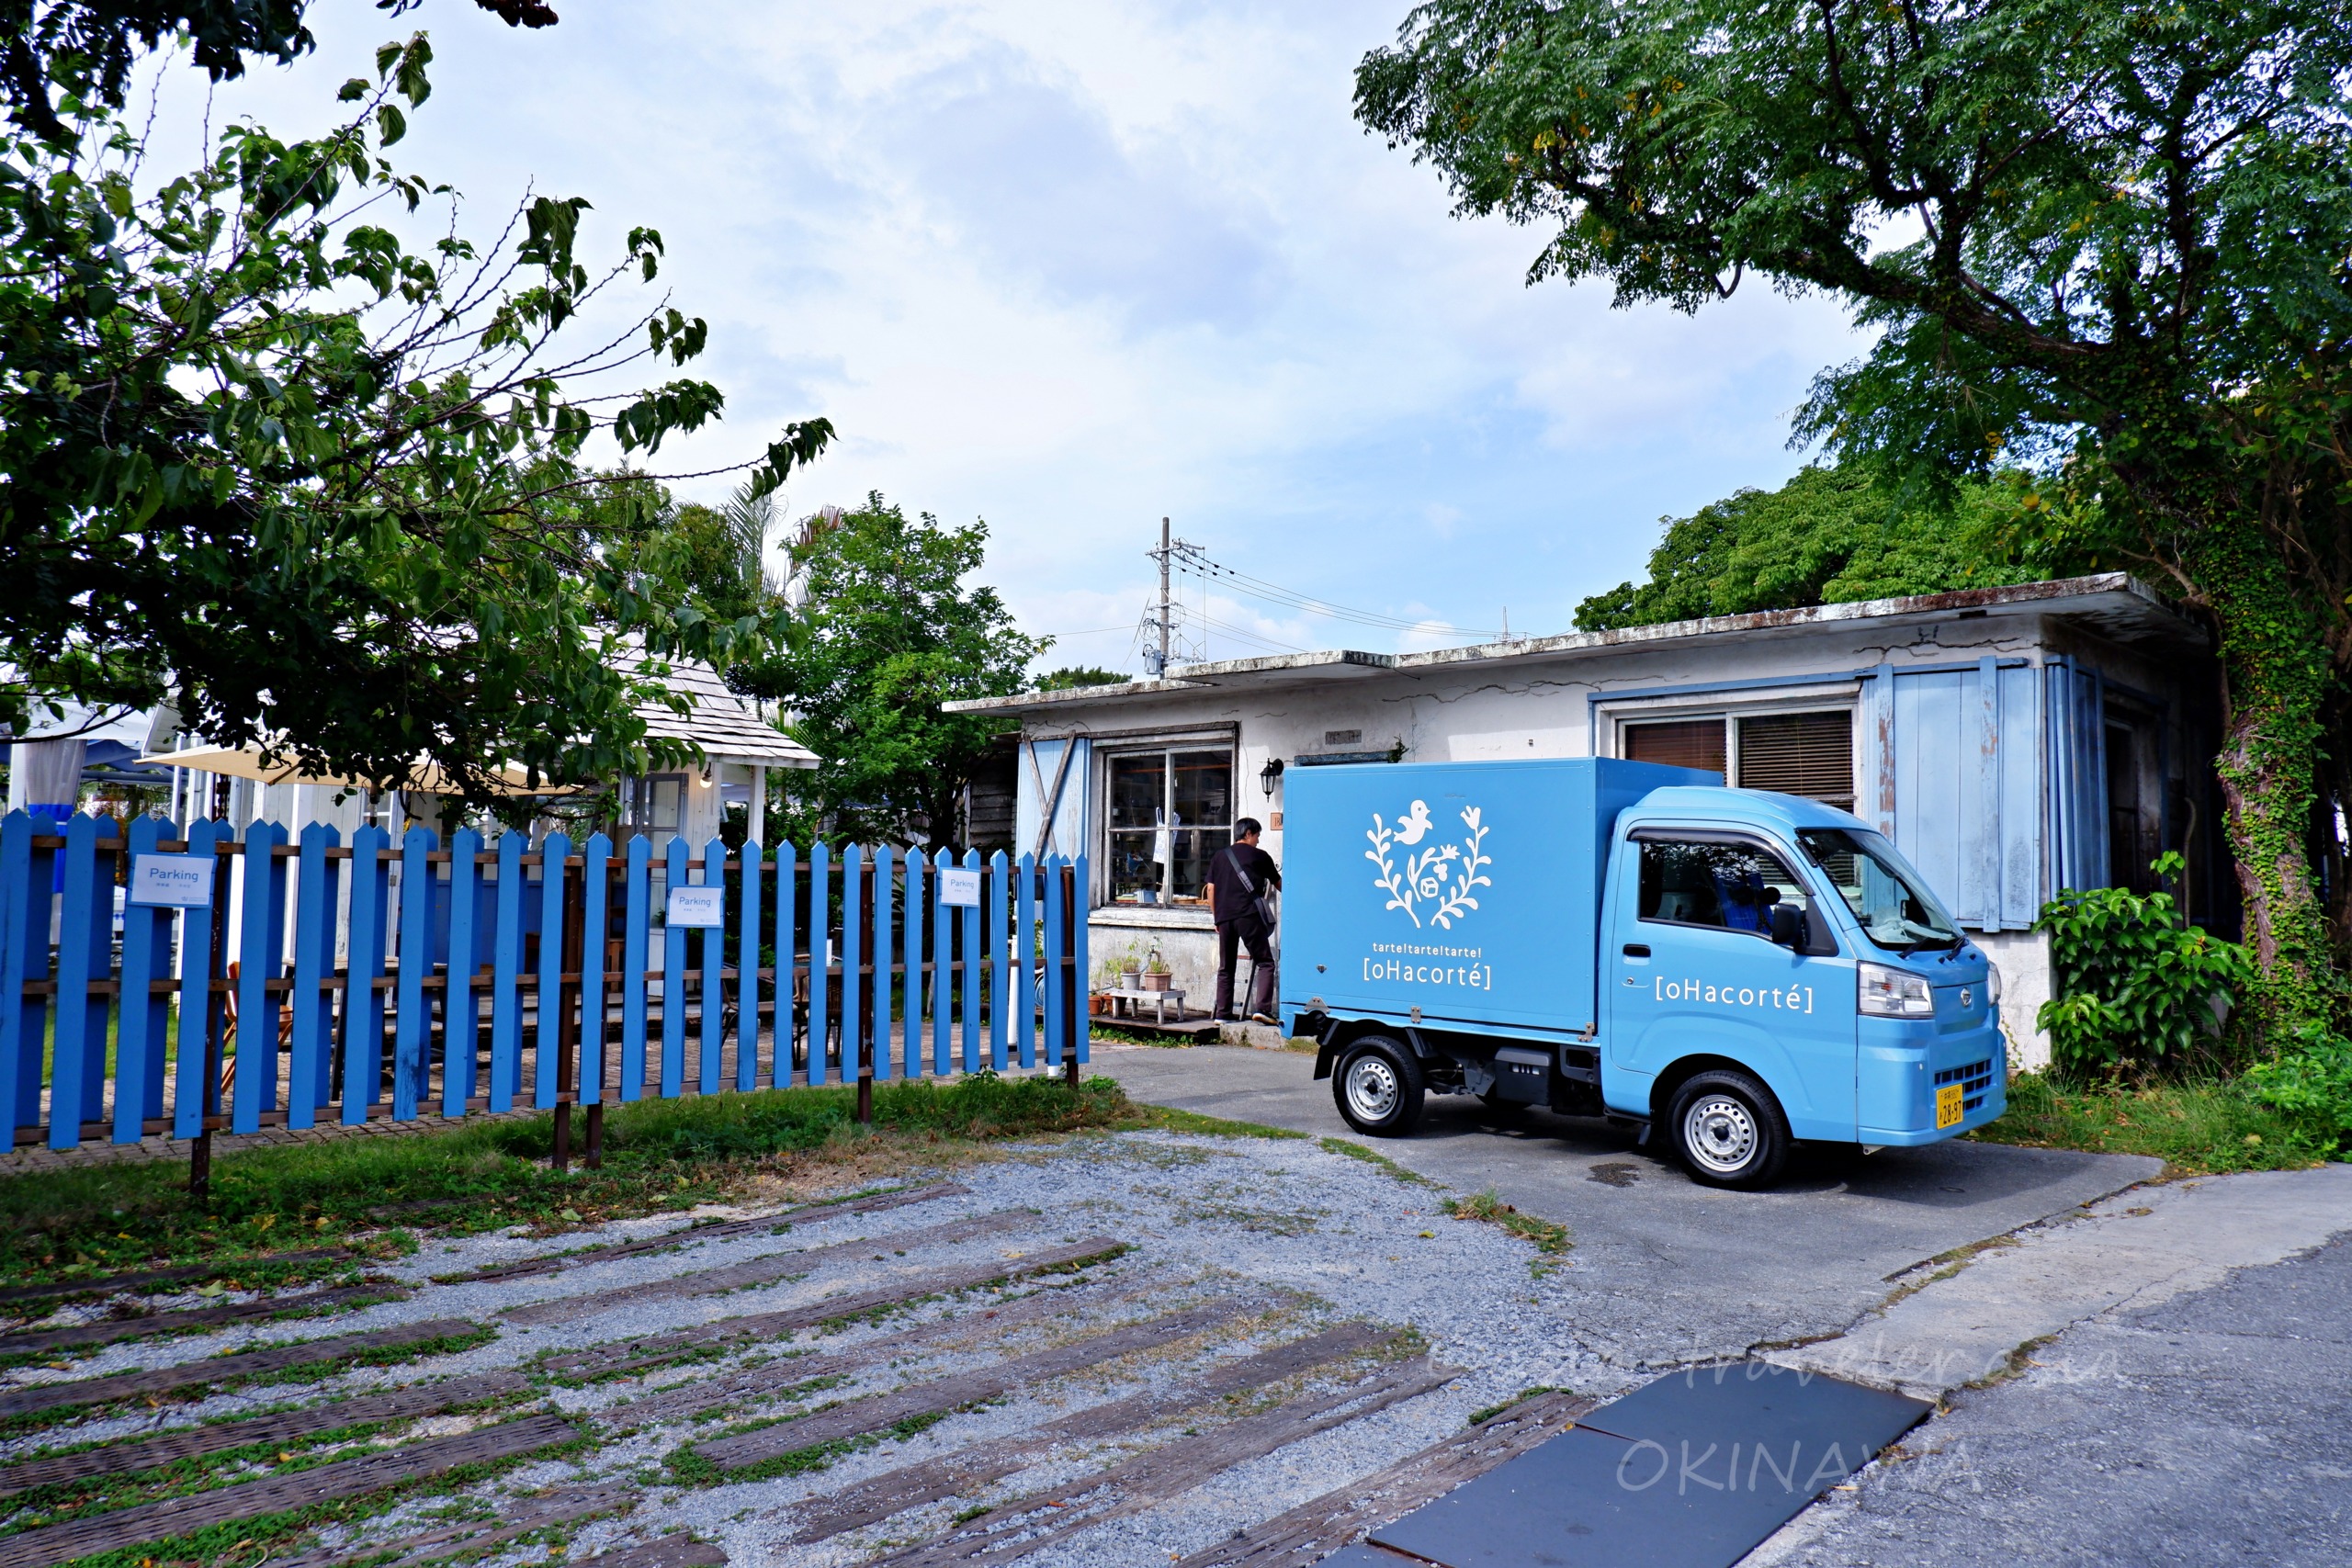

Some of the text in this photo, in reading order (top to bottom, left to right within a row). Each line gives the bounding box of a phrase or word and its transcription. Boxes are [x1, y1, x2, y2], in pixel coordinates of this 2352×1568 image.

[150, 867, 198, 883] Parking
[950, 878, 975, 889] Parking
[679, 897, 711, 908] Parking
[1373, 942, 1482, 958] tarte!tarte!tarte!
[1363, 957, 1490, 990] [oHacorté]
[1656, 976, 1813, 1014] [oHacorté]
